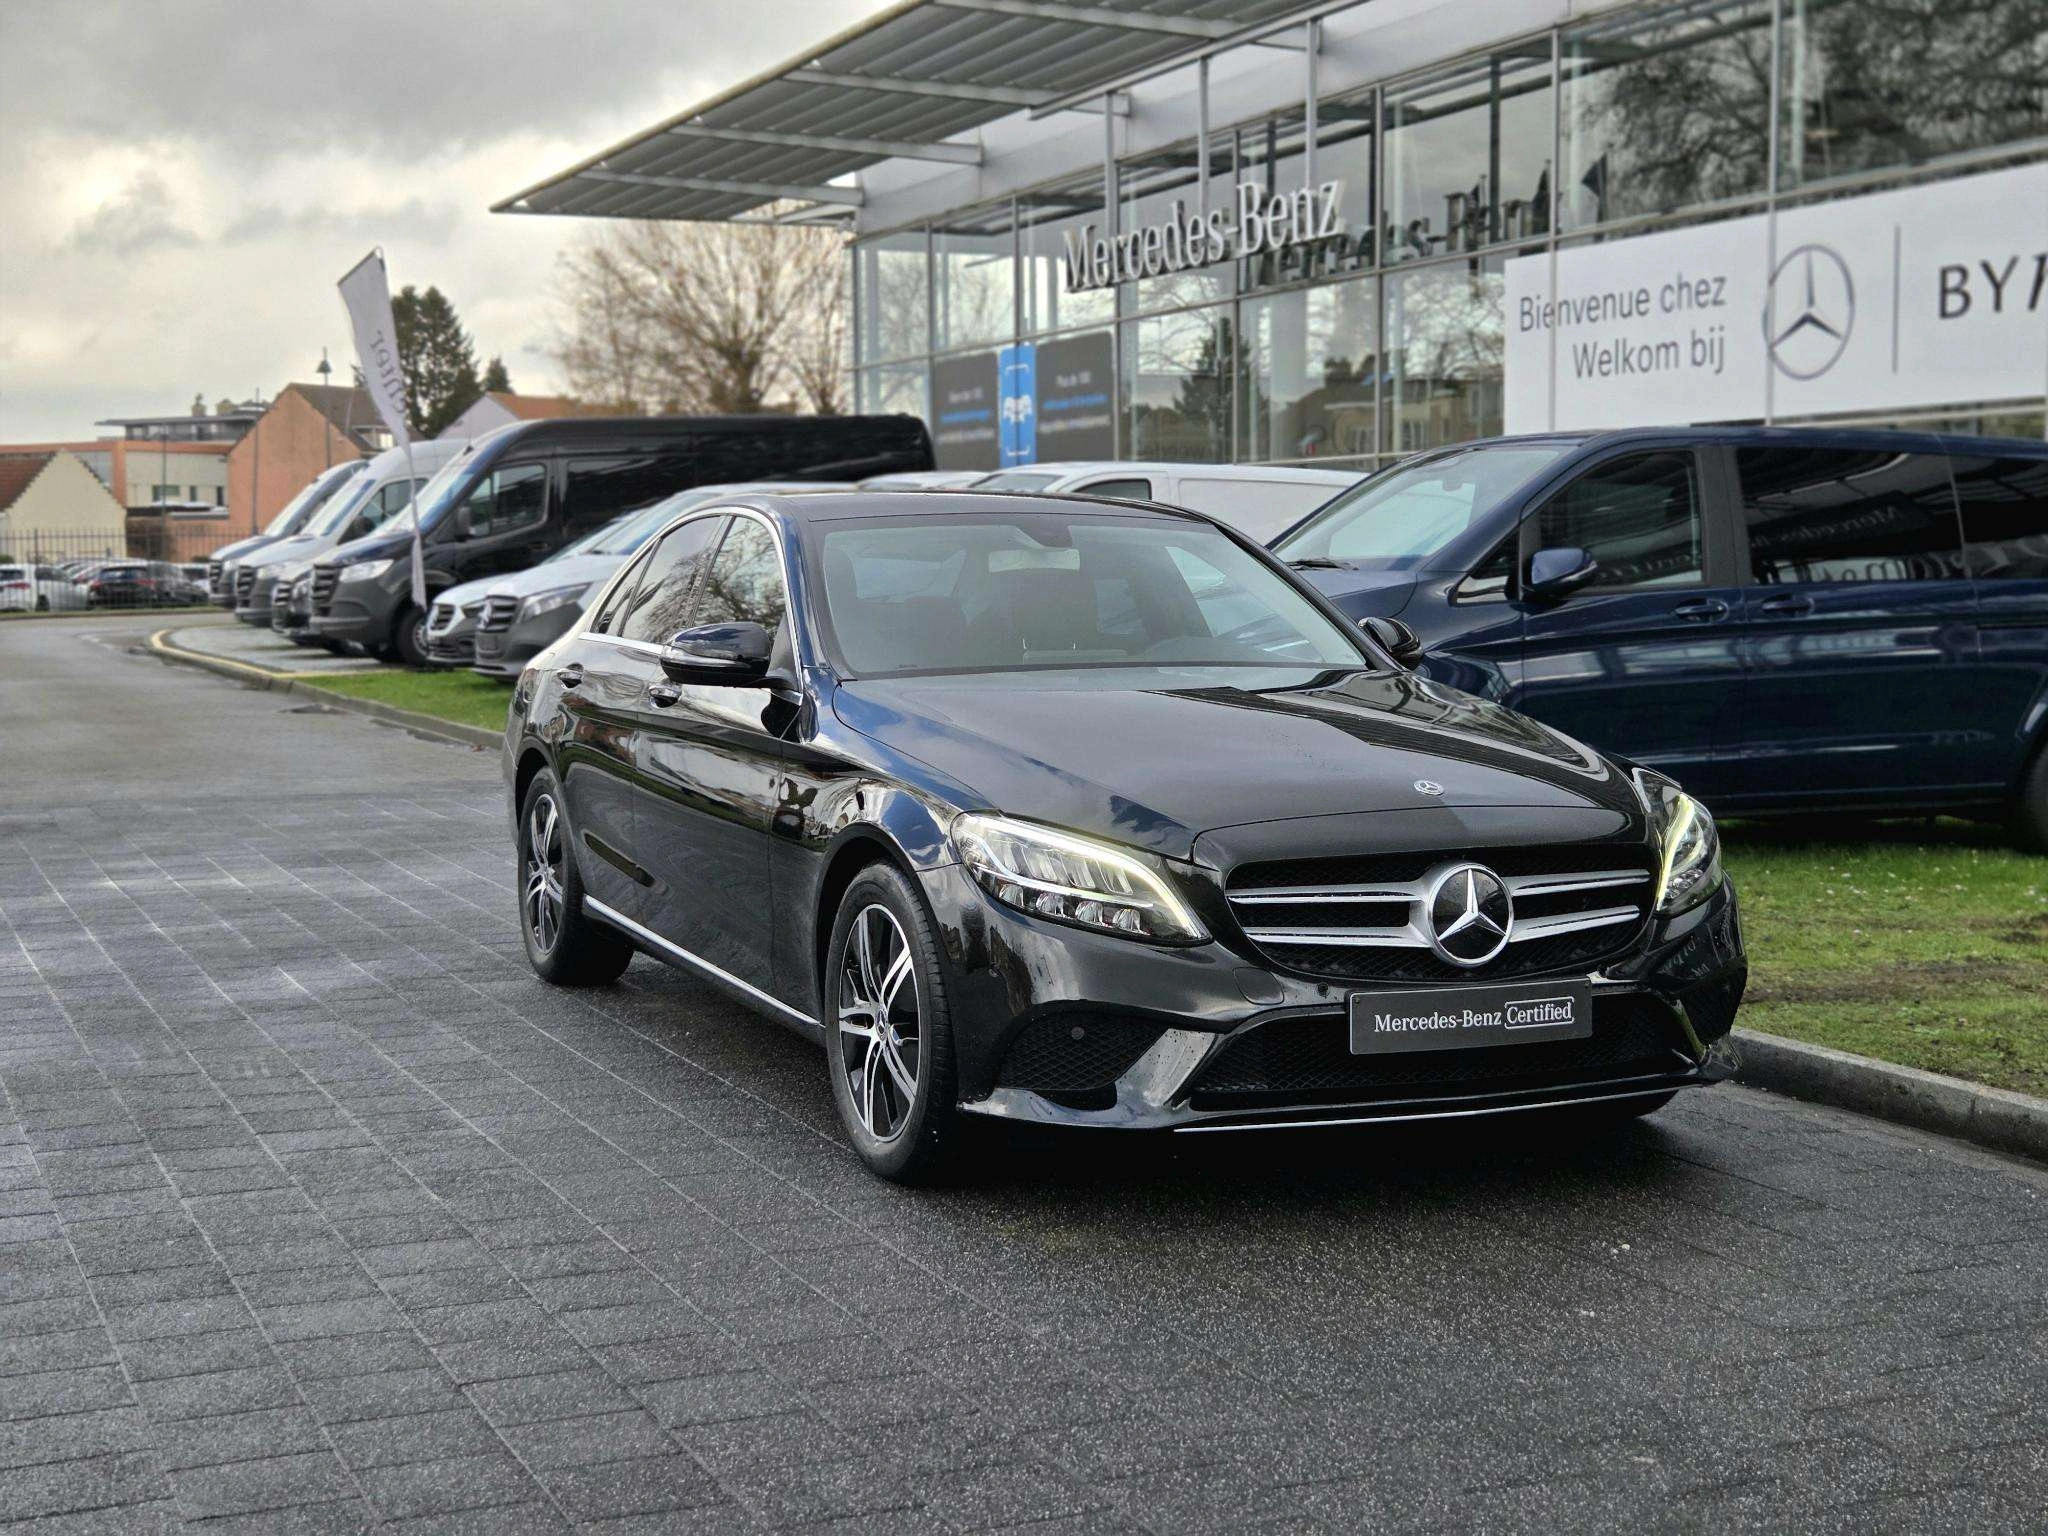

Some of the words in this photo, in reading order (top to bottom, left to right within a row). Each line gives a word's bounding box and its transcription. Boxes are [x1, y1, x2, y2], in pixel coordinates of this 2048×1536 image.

[1063, 178, 1344, 293] Mercedes-Benz
[1519, 286, 1650, 332] Bienvenue
[1660, 271, 1727, 314] chez
[1572, 336, 1680, 379] Welkom
[1690, 324, 1725, 375] bij
[1374, 1008, 1502, 1032] Mercedes-Benz
[1506, 1001, 1572, 1024] Certified
